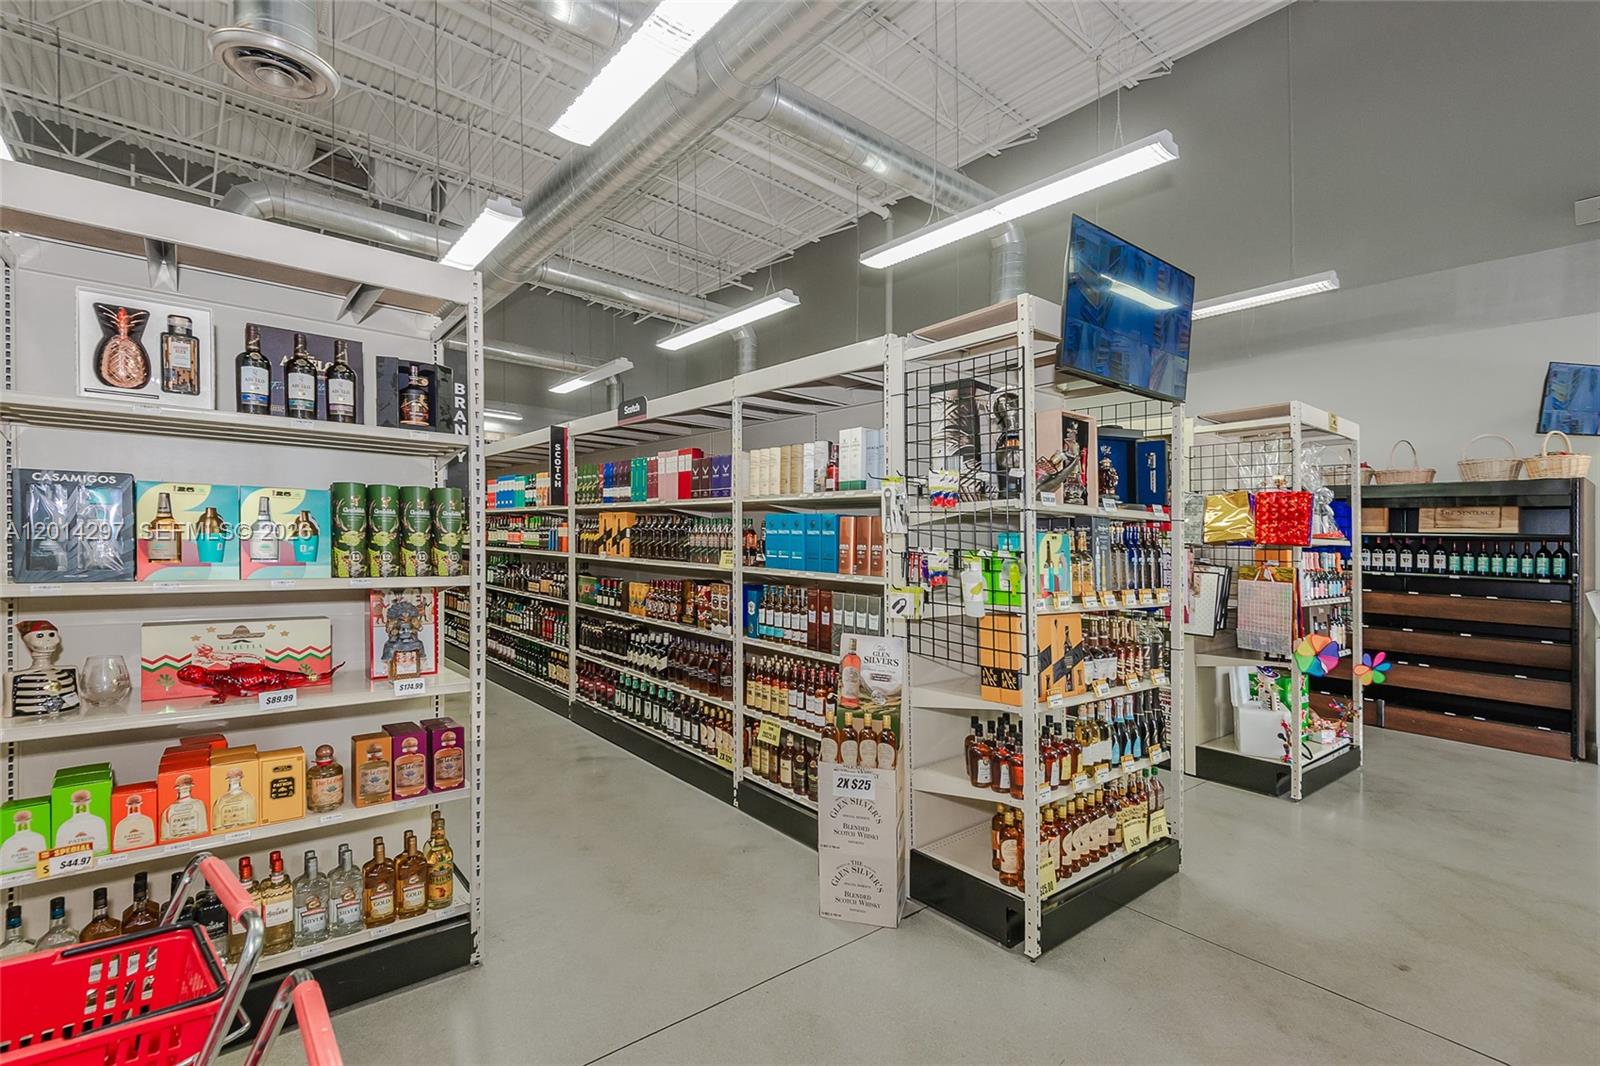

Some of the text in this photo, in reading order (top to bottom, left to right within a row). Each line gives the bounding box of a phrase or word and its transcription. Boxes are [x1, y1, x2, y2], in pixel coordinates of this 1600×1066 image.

[624, 403, 640, 415] Scotch
[454, 382, 467, 463] BRANY
[32, 472, 117, 484] CASAMIGOS
[399, 681, 424, 692] $174.99
[265, 694, 294, 705] $89.99
[837, 777, 872, 791] 2X $25
[829, 799, 849, 819] GLEN
[60, 856, 92, 870] $44.97
[830, 867, 850, 887] GLEN
[406, 890, 423, 898] GOLD
[373, 898, 391, 907] GOLD
